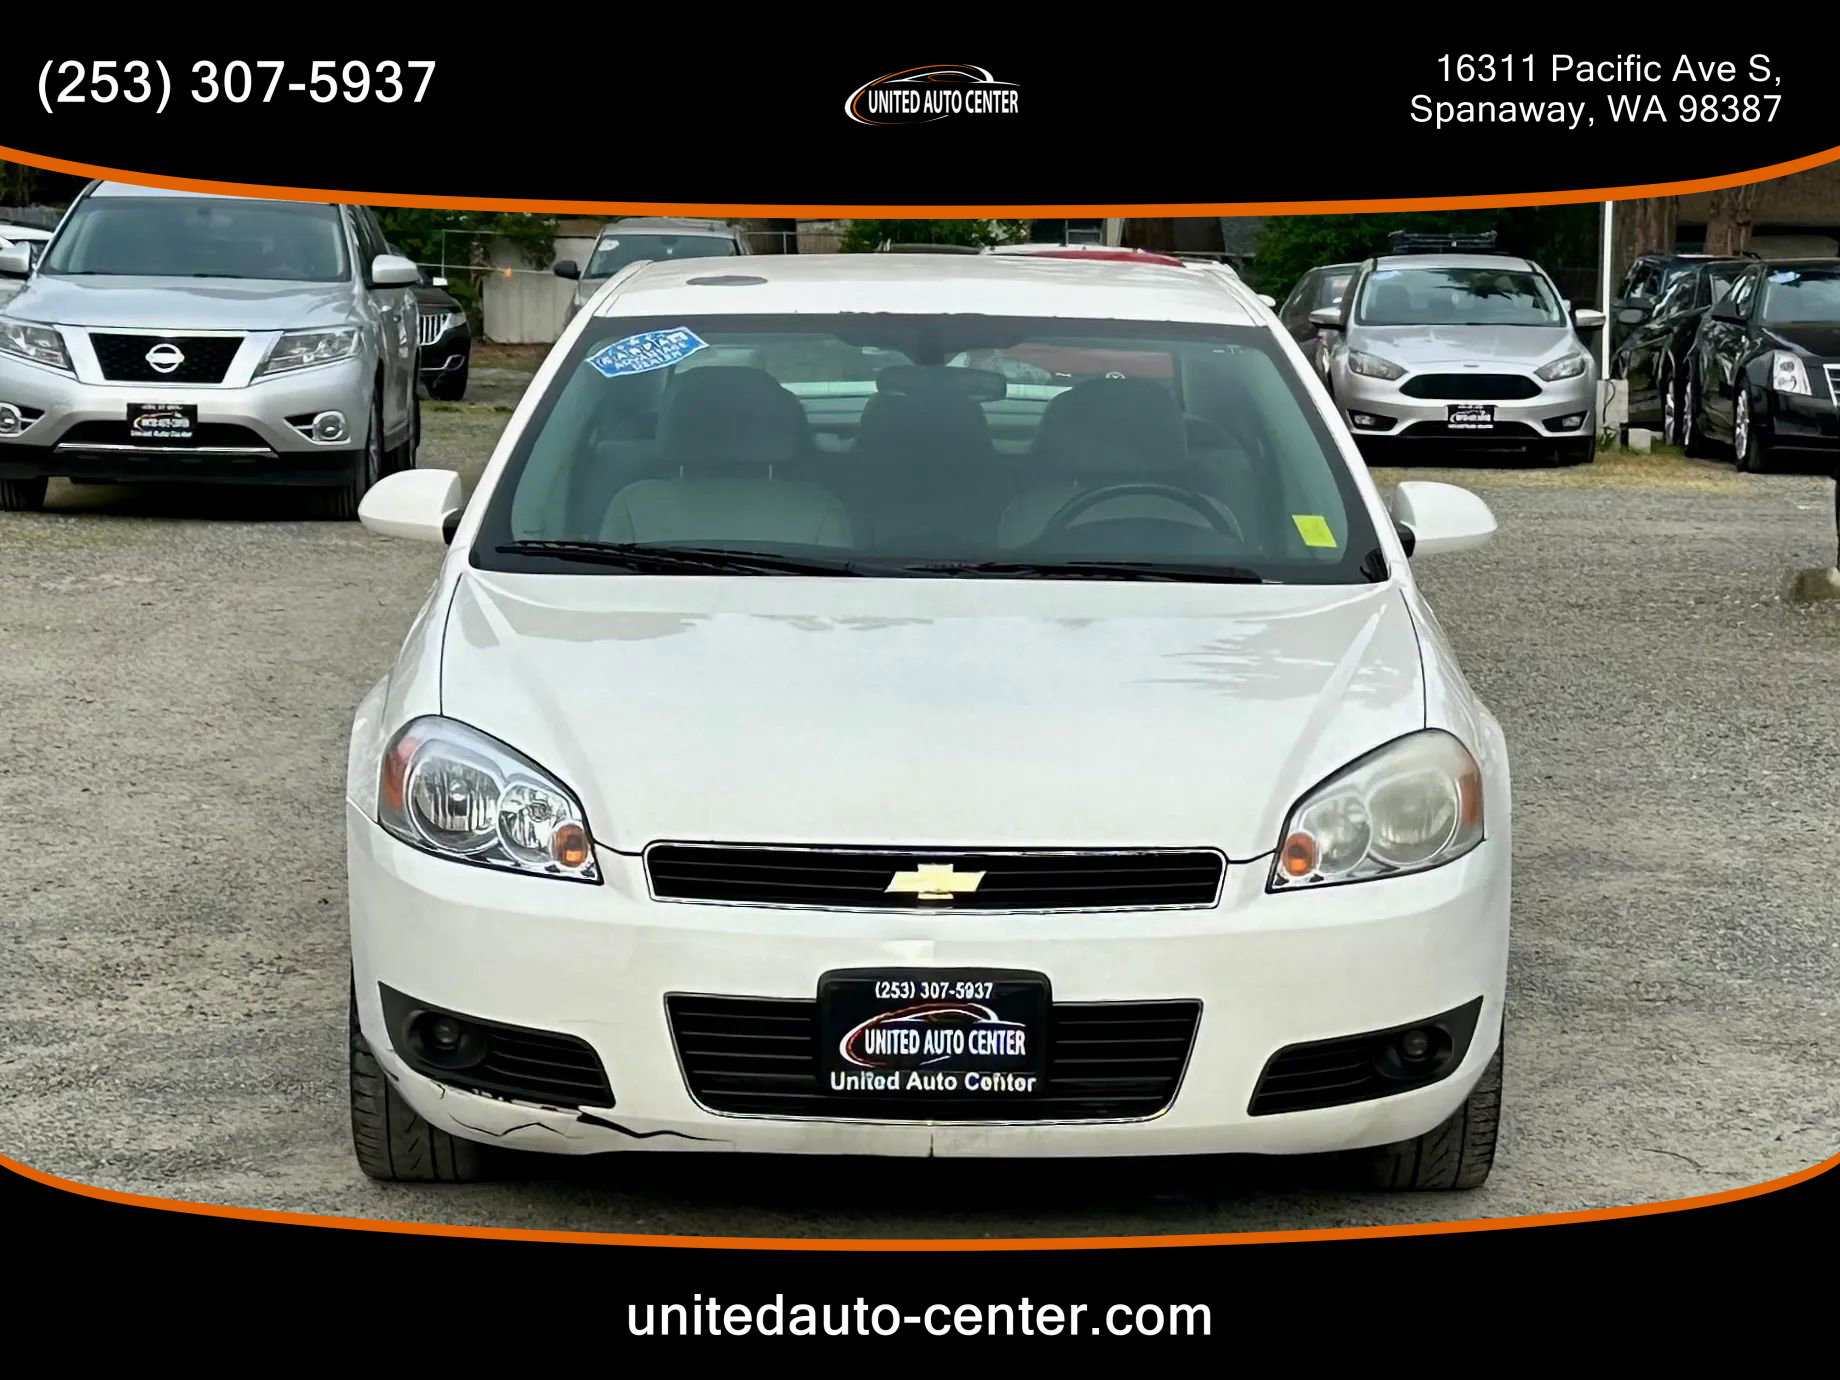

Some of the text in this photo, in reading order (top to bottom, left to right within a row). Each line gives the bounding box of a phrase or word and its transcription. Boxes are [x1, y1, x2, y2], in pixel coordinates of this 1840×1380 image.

[875, 981, 994, 1000] (253) 307-5937
[864, 1029, 1026, 1055] UNITED AUTO CENTER
[830, 1071, 900, 1091] United
[905, 1071, 958, 1091] Auto
